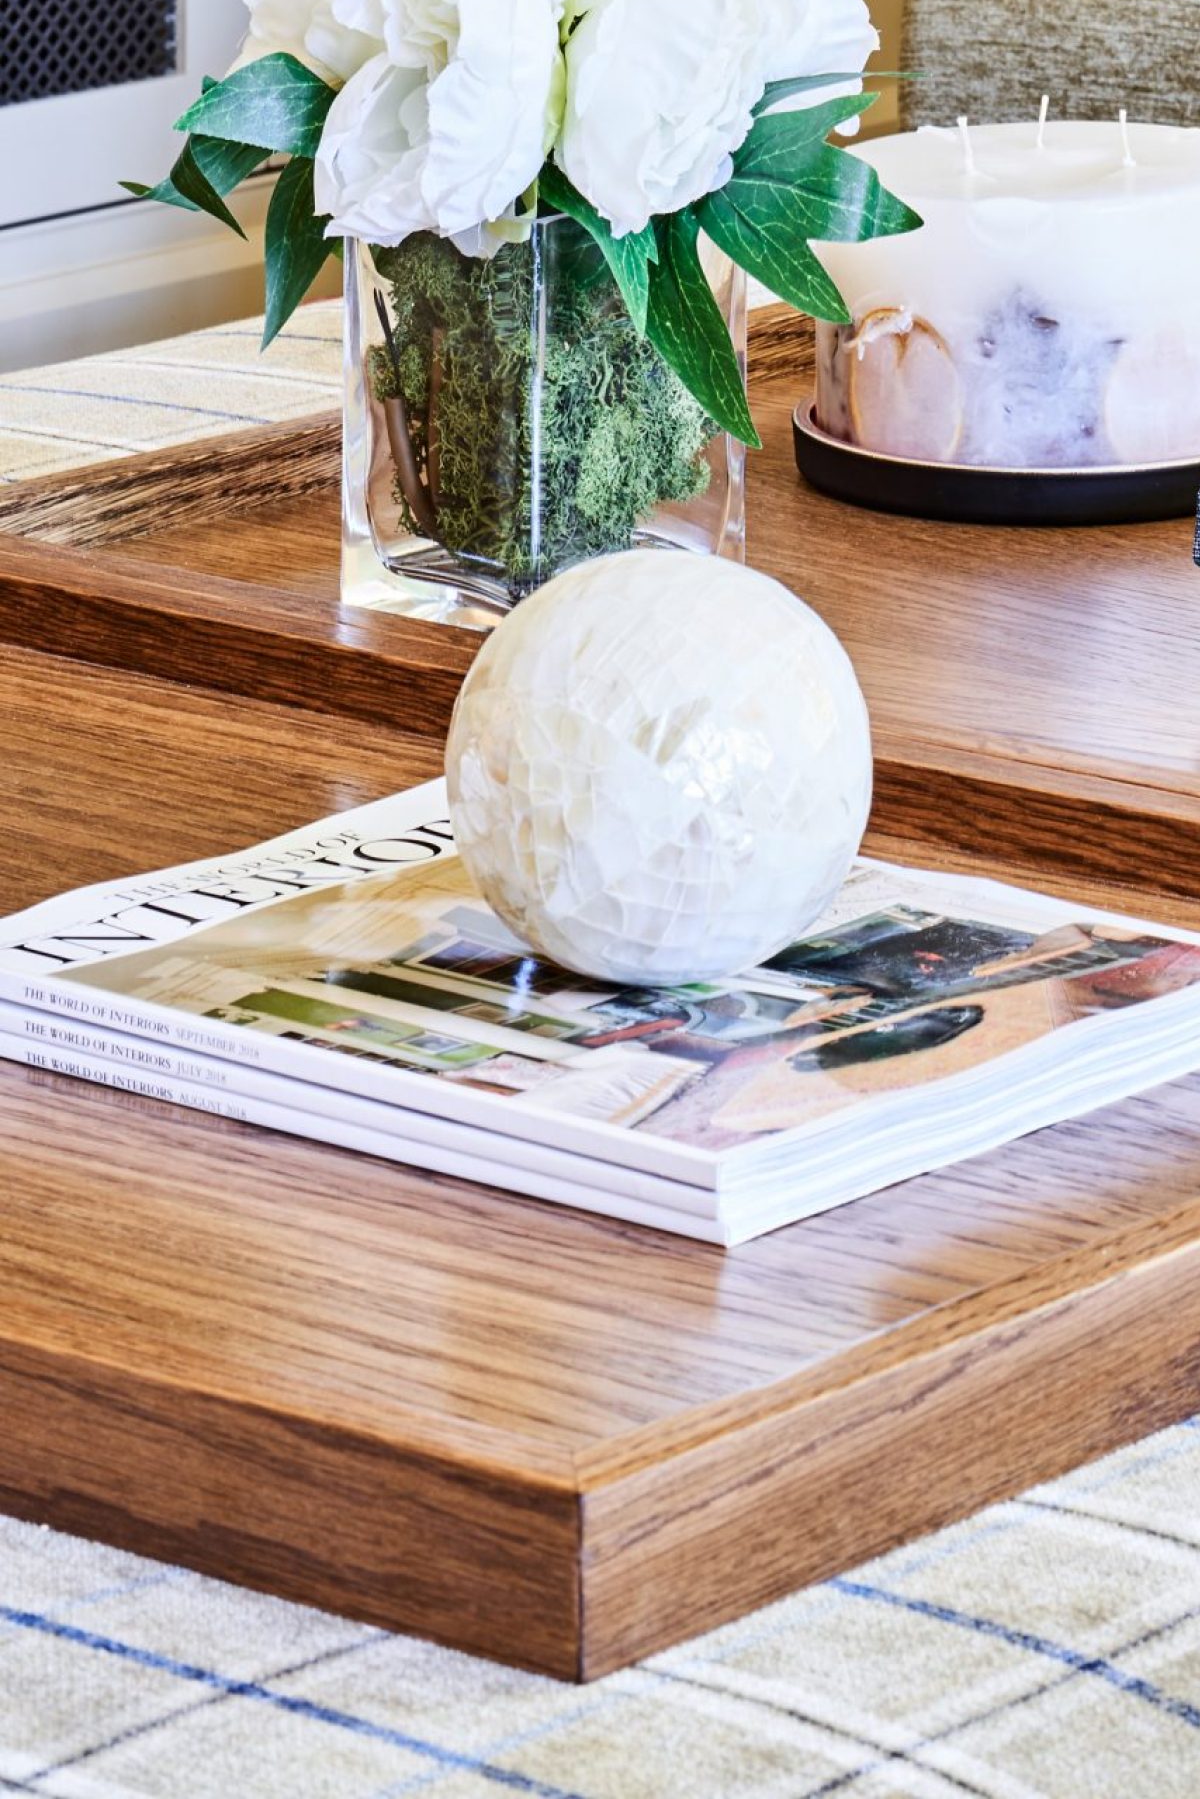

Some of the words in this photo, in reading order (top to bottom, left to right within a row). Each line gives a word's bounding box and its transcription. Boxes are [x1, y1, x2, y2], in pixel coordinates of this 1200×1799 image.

[316, 832, 360, 848] OF
[24, 986, 46, 1001] THE
[49, 994, 90, 1013] WORLD
[92, 1006, 107, 1017] OF
[110, 1009, 170, 1036] INTERIORS
[176, 1027, 236, 1053] SEPTEMBER
[24, 1020, 49, 1036] THE
[50, 1027, 91, 1047] WORLD
[93, 1040, 107, 1052] OF
[111, 1043, 172, 1070] INTERIORS
[177, 1061, 203, 1078] JULY
[25, 1051, 48, 1066] THE
[51, 1058, 91, 1078] WORLD
[94, 1071, 108, 1083] OF
[112, 1074, 174, 1100] INTERIORS
[180, 1092, 221, 1113] AUGUST
